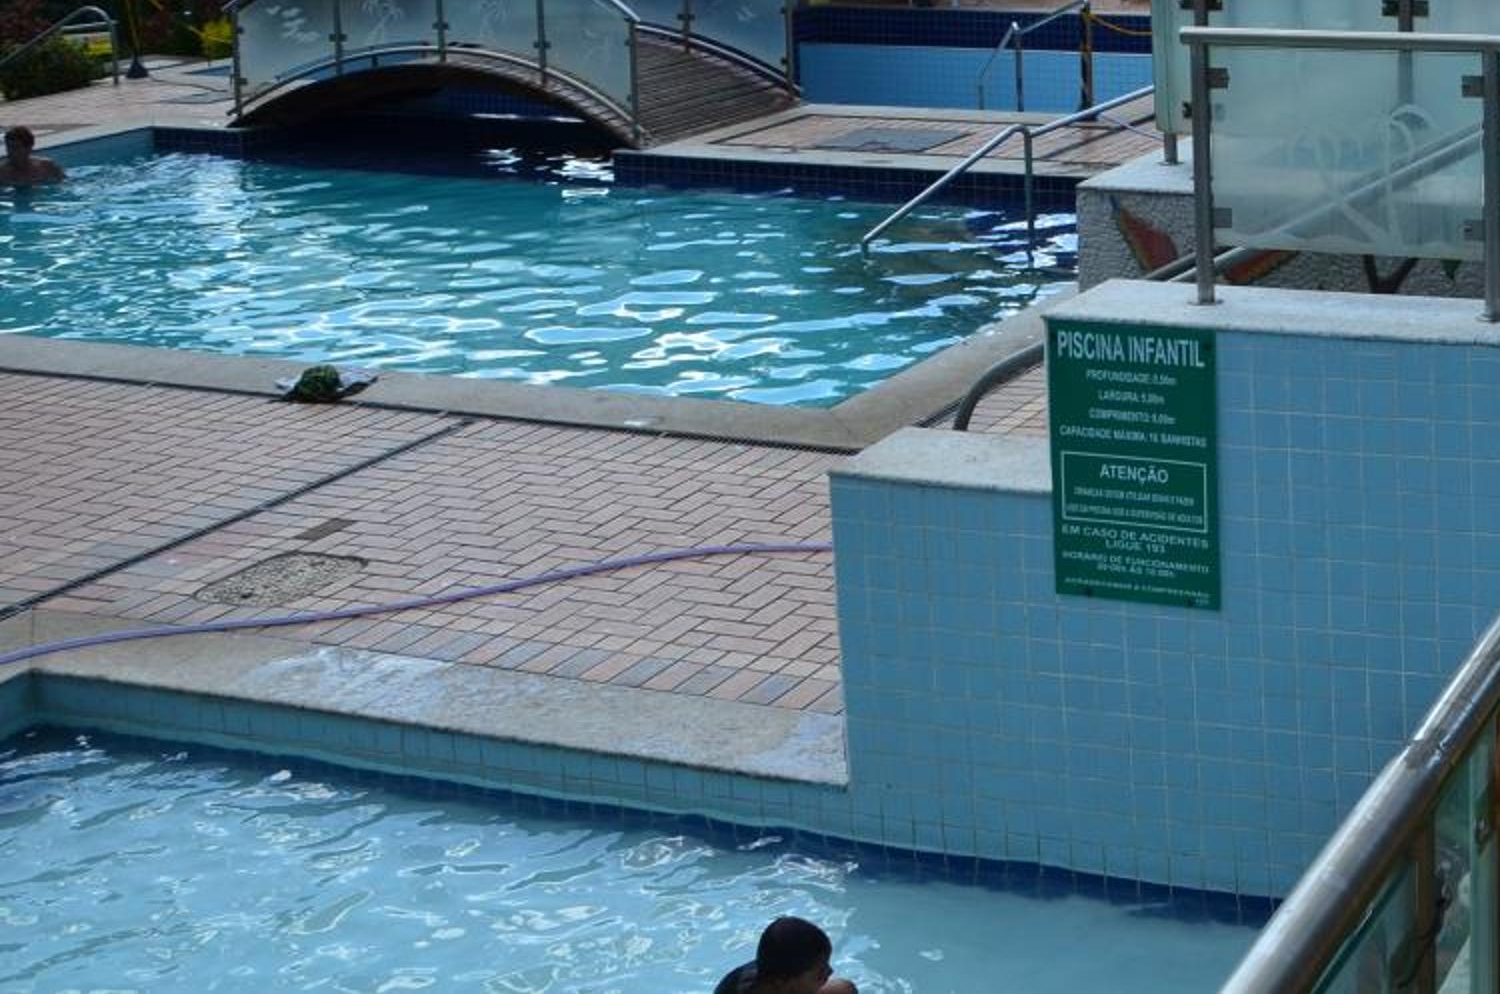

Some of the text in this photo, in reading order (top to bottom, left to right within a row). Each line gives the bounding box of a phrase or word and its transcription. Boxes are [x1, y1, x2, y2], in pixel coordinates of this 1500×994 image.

[1057, 330, 1206, 367] PISCINA INFANTIL
[1099, 463, 1169, 484] ATENÇÃO
[1061, 524, 1209, 549] EM CASO DE ACIDENTES
